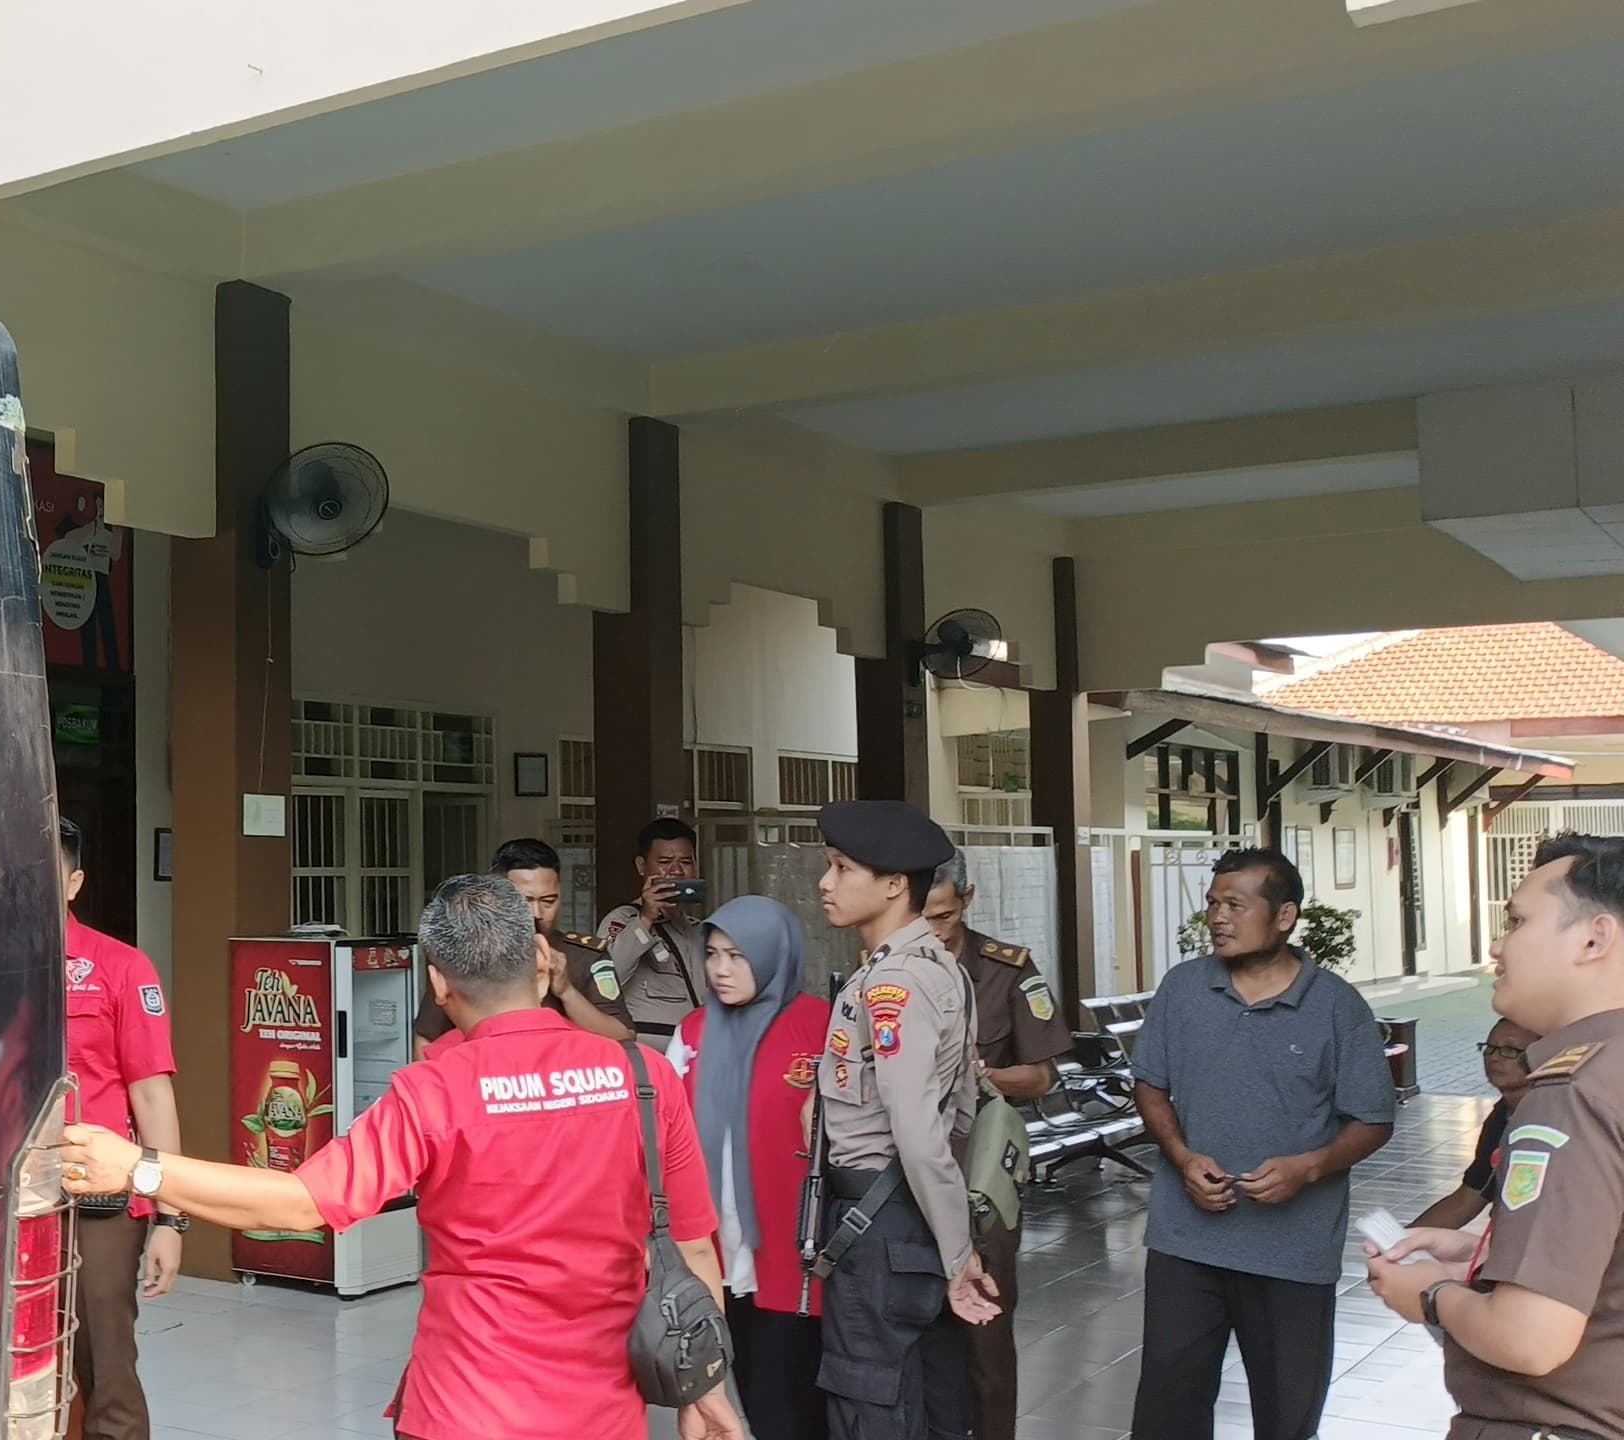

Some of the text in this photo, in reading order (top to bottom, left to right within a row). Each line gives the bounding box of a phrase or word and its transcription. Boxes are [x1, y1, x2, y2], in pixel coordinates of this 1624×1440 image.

[255, 967, 284, 994] Teh
[240, 988, 322, 1033] JAVANA
[479, 1066, 625, 1101] PIDUM SQUAD
